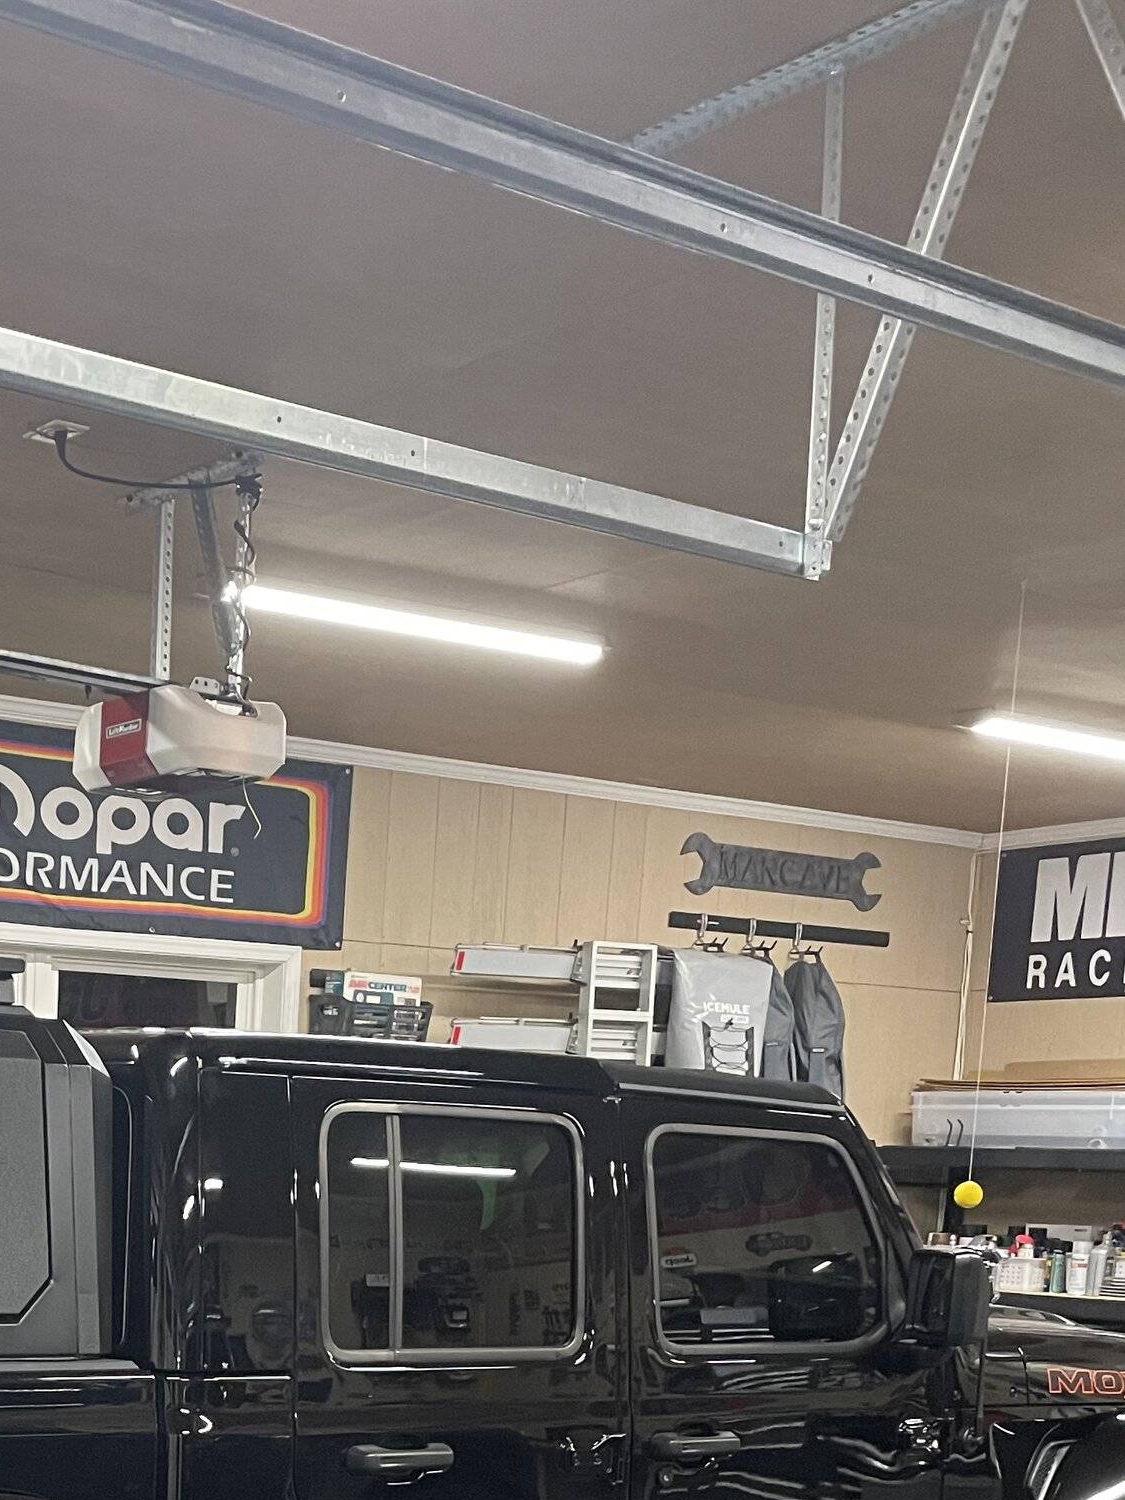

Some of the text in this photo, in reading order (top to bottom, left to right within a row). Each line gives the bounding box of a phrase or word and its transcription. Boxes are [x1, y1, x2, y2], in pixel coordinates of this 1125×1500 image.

[1029, 851, 1125, 943] M
[1026, 948, 1125, 989] RAC
[703, 1001, 751, 1015] ICEMULE
[1046, 1367, 1125, 1398] MO
